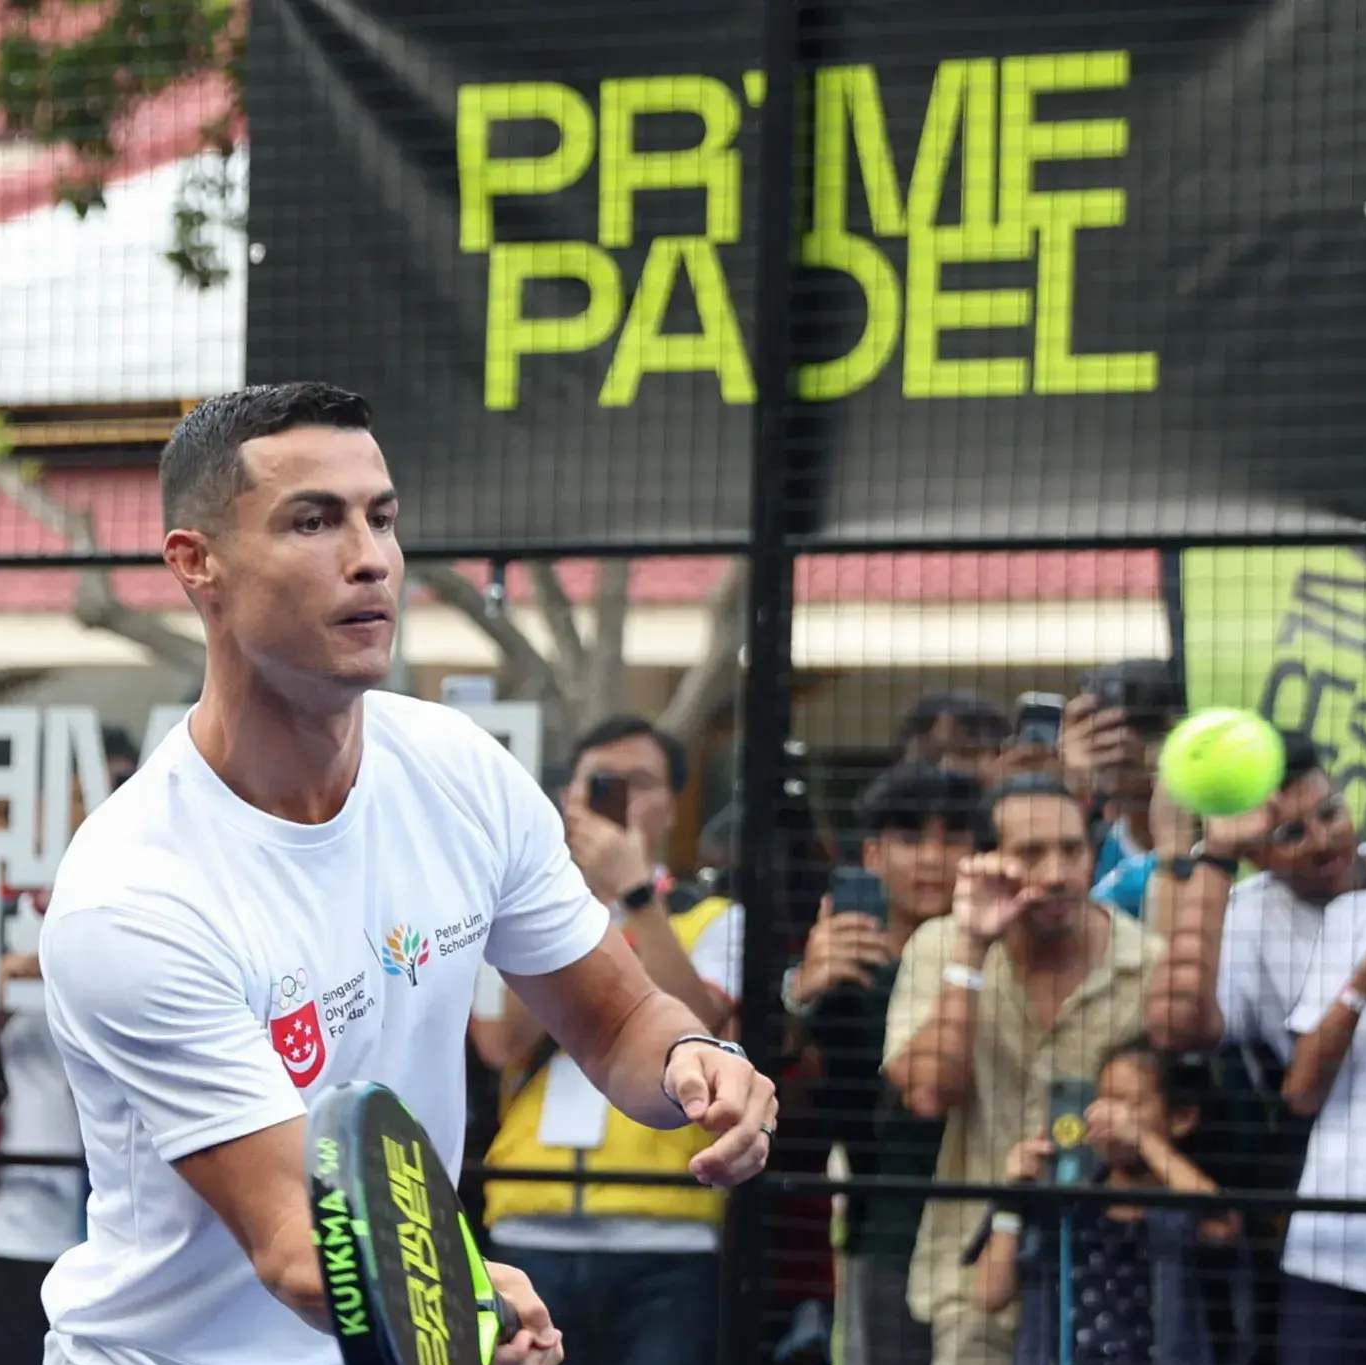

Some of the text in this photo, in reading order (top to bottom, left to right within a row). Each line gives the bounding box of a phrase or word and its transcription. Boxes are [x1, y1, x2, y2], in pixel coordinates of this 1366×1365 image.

[456, 49, 1130, 252] PRME
[435, 913, 483, 941] Peter Lim
[317, 1188, 370, 1337] KUIKMA
